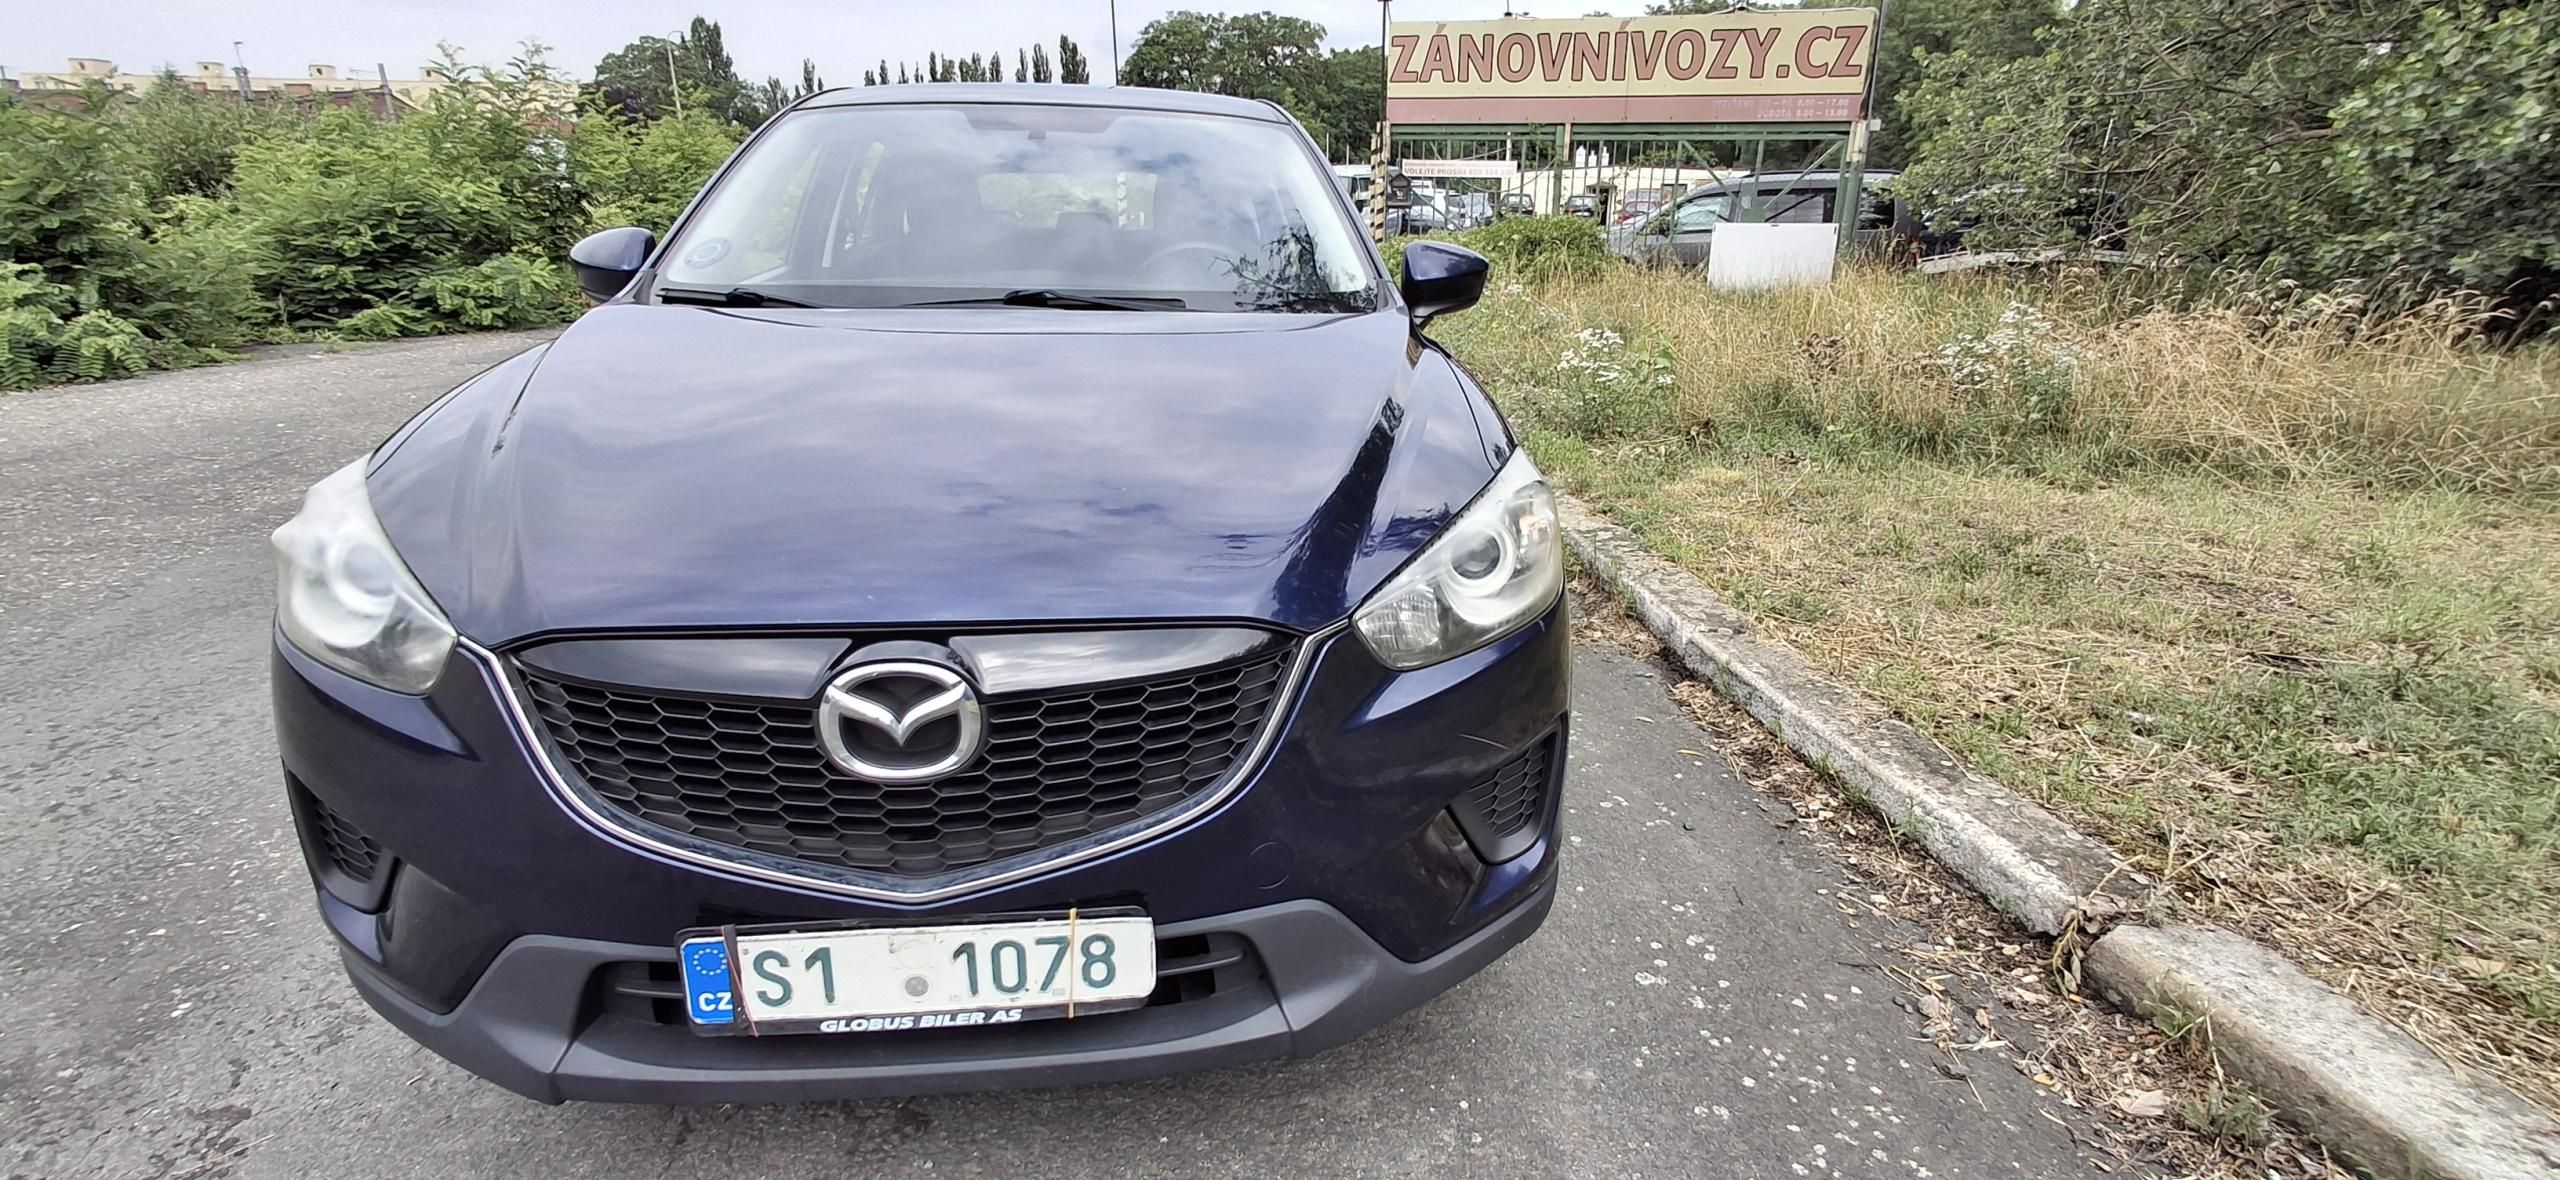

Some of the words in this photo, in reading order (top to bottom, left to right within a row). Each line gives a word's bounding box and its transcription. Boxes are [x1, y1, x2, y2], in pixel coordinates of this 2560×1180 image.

[1390, 21, 1868, 83] ZÁNOVNÍVOZY.CZ
[753, 946, 836, 1007] S1
[952, 933, 1117, 997] 1078
[698, 991, 734, 1012] CZ
[819, 1016, 915, 1033] GLOBUS
[919, 1012, 986, 1028] BILER
[990, 1008, 1023, 1023] AS
